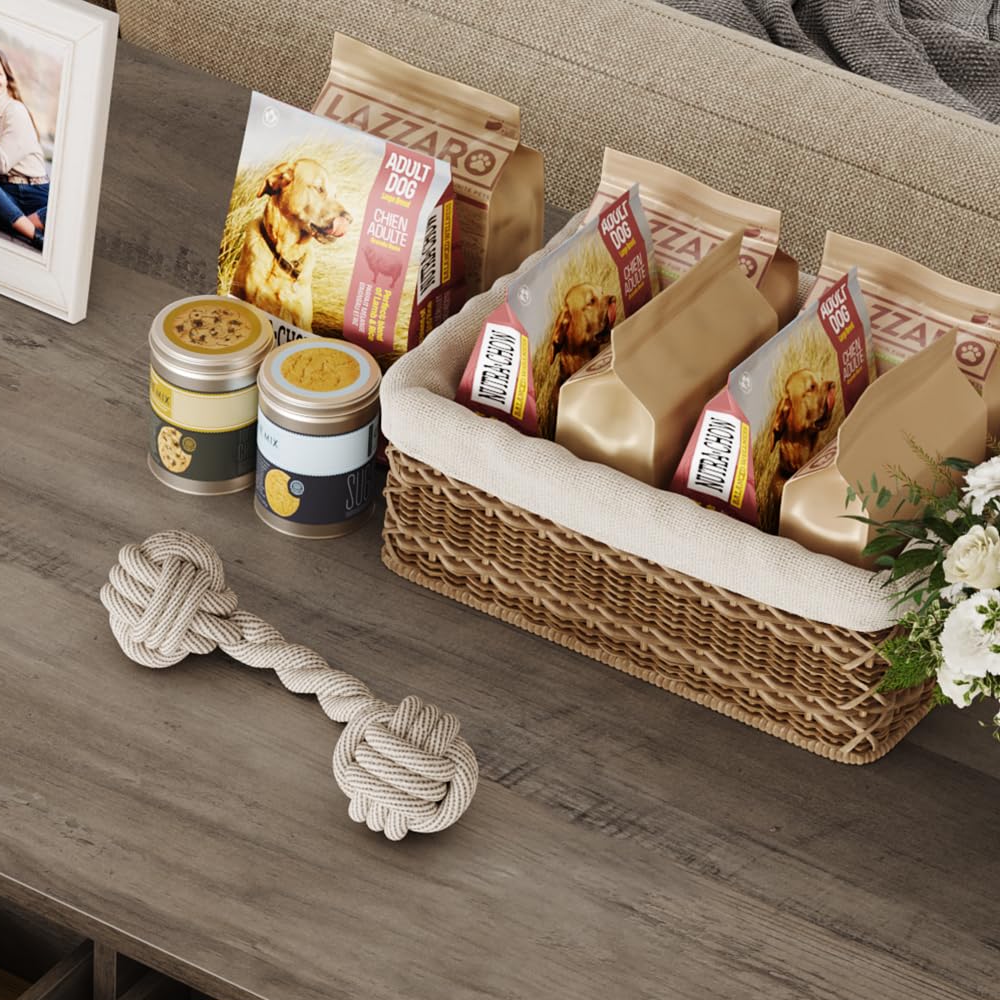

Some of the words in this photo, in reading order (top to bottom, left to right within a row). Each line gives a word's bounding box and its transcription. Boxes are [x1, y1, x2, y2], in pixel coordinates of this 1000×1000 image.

[385, 152, 431, 182] ADULT
[384, 174, 418, 200] DOG
[374, 209, 408, 232] CHIEN
[600, 199, 629, 236] ADULT
[367, 222, 408, 247] ADULTE
[610, 222, 632, 250] DOG
[623, 253, 643, 281] CHIEN
[624, 269, 647, 295] ADULTE
[820, 283, 848, 319] ADULT
[829, 306, 850, 335] DOG
[843, 336, 862, 365] CHIEN
[843, 352, 865, 382] ADULTE
[264, 432, 279, 448] MIX
